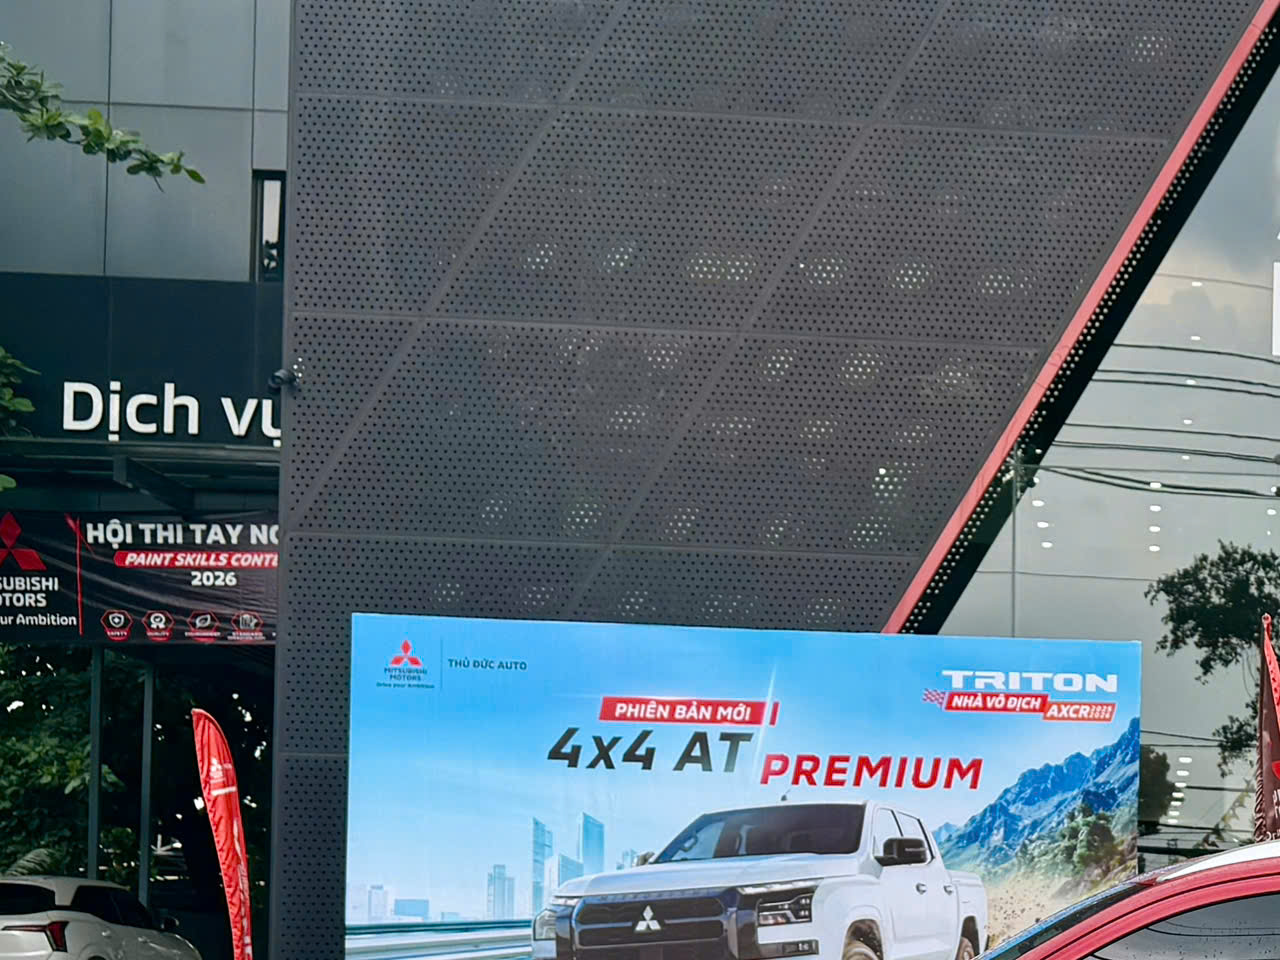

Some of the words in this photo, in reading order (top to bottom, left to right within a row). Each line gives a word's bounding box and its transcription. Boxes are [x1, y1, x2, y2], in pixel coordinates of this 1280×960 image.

[62, 381, 199, 442] Dịch
[86, 519, 133, 550] HỘI
[138, 523, 184, 545] THI
[189, 523, 244, 545] TAY
[125, 552, 172, 567] PAINT
[175, 553, 227, 567] SKILLS
[190, 571, 238, 587] 2026
[0, 592, 47, 607] TORS
[16, 613, 77, 626] Ambition
[448, 656, 470, 669] THỦ
[472, 657, 495, 669] ĐỨC
[497, 661, 528, 671] AUTO
[941, 670, 1118, 693] TRITON
[615, 701, 670, 719] PHIÊN
[674, 701, 713, 720] BẢN
[716, 703, 751, 721] MỚI
[951, 692, 984, 709] NHÀ
[986, 692, 1008, 709] VÔ
[1006, 697, 1042, 711] ĐỊCH
[1046, 704, 1090, 719] AXCR
[546, 727, 657, 772] 4x4
[672, 730, 755, 773] AT
[759, 753, 984, 790] PREMIUM
